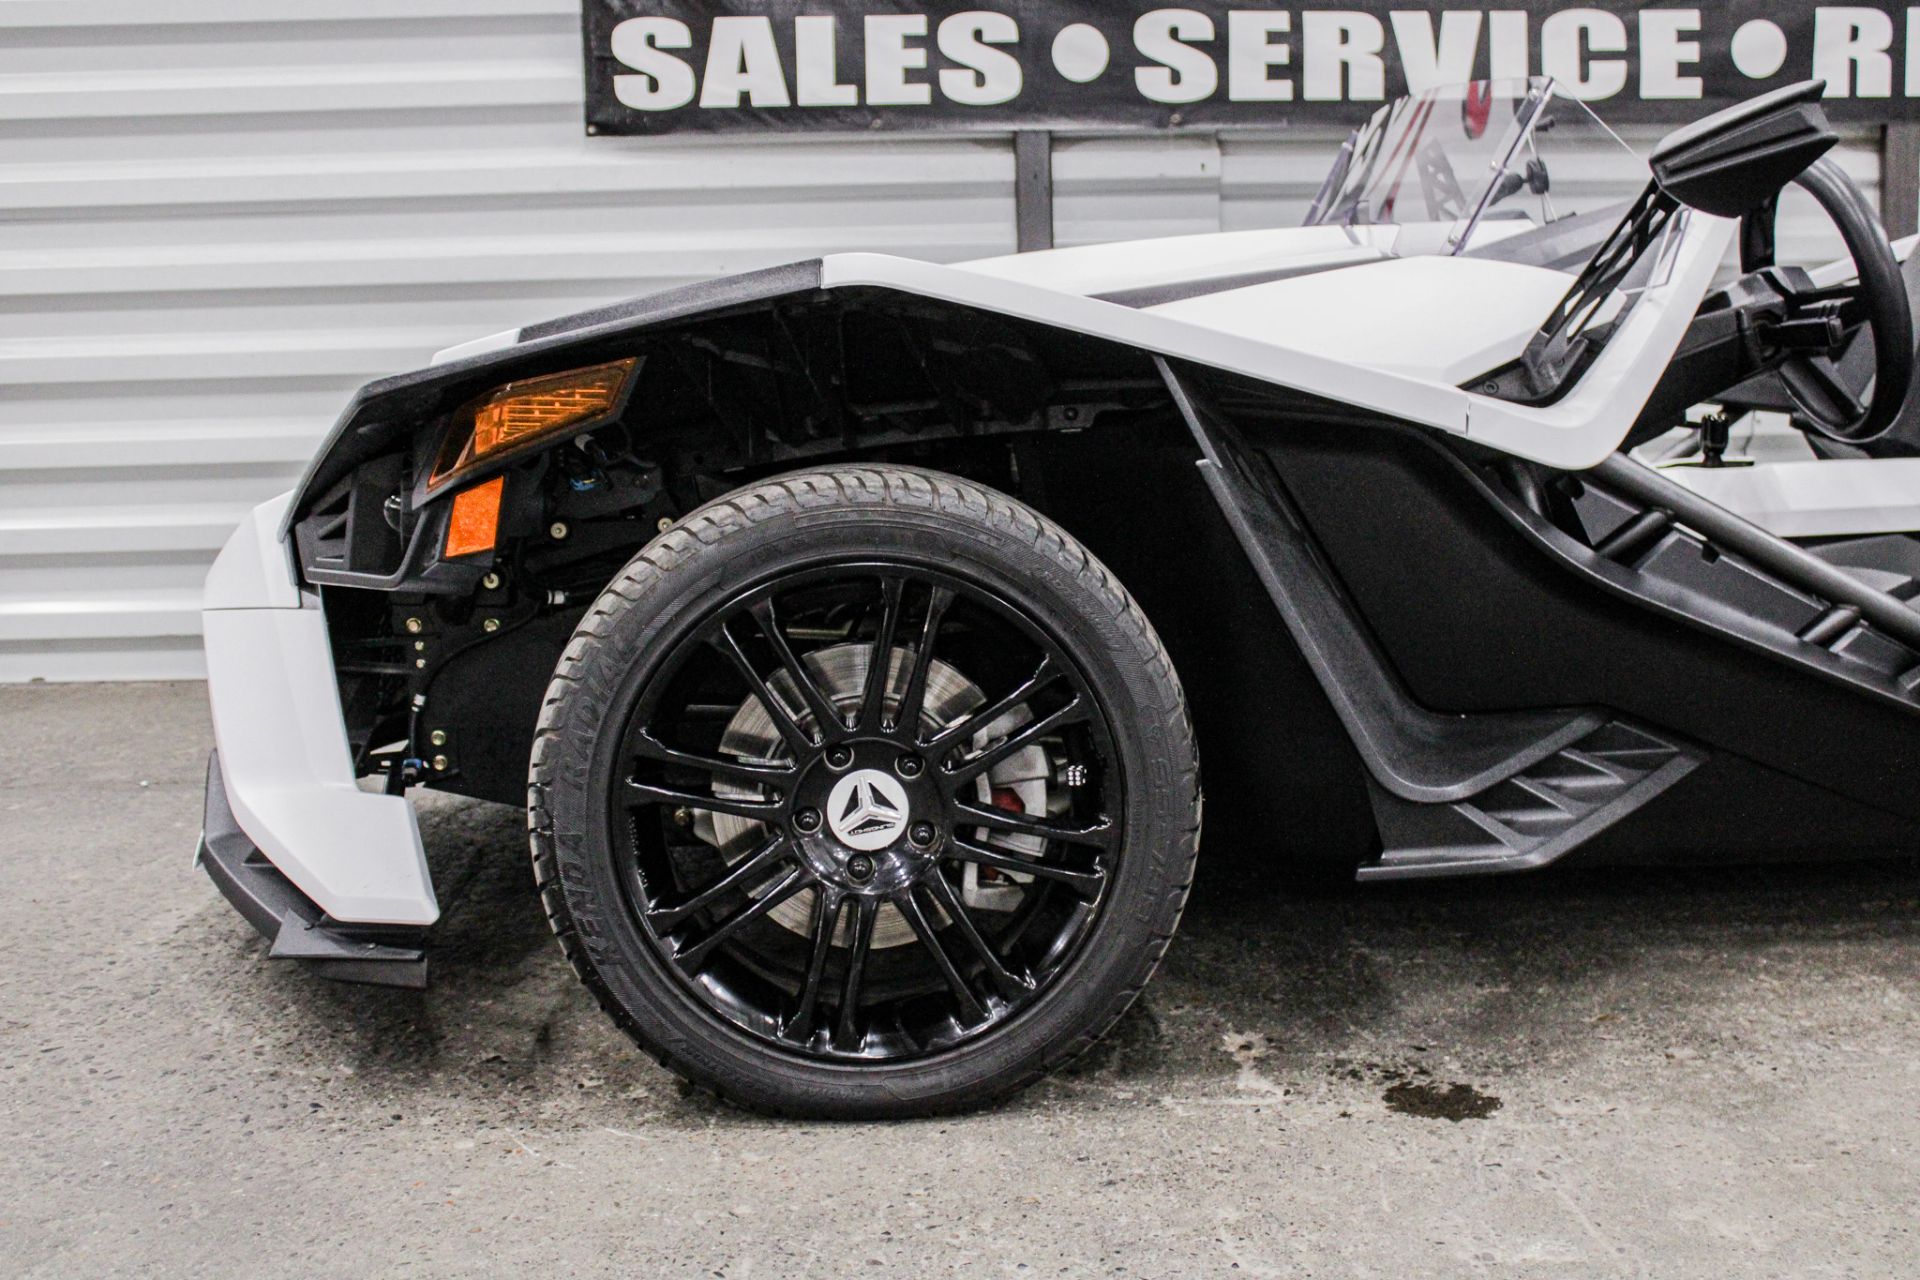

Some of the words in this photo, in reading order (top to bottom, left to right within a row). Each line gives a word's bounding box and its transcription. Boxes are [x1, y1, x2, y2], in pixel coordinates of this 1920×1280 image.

[611, 11, 1022, 111] SALES
[1133, 8, 1704, 103] SERVICE
[1812, 6, 1920, 99] R
[557, 831, 623, 965] KENDA
